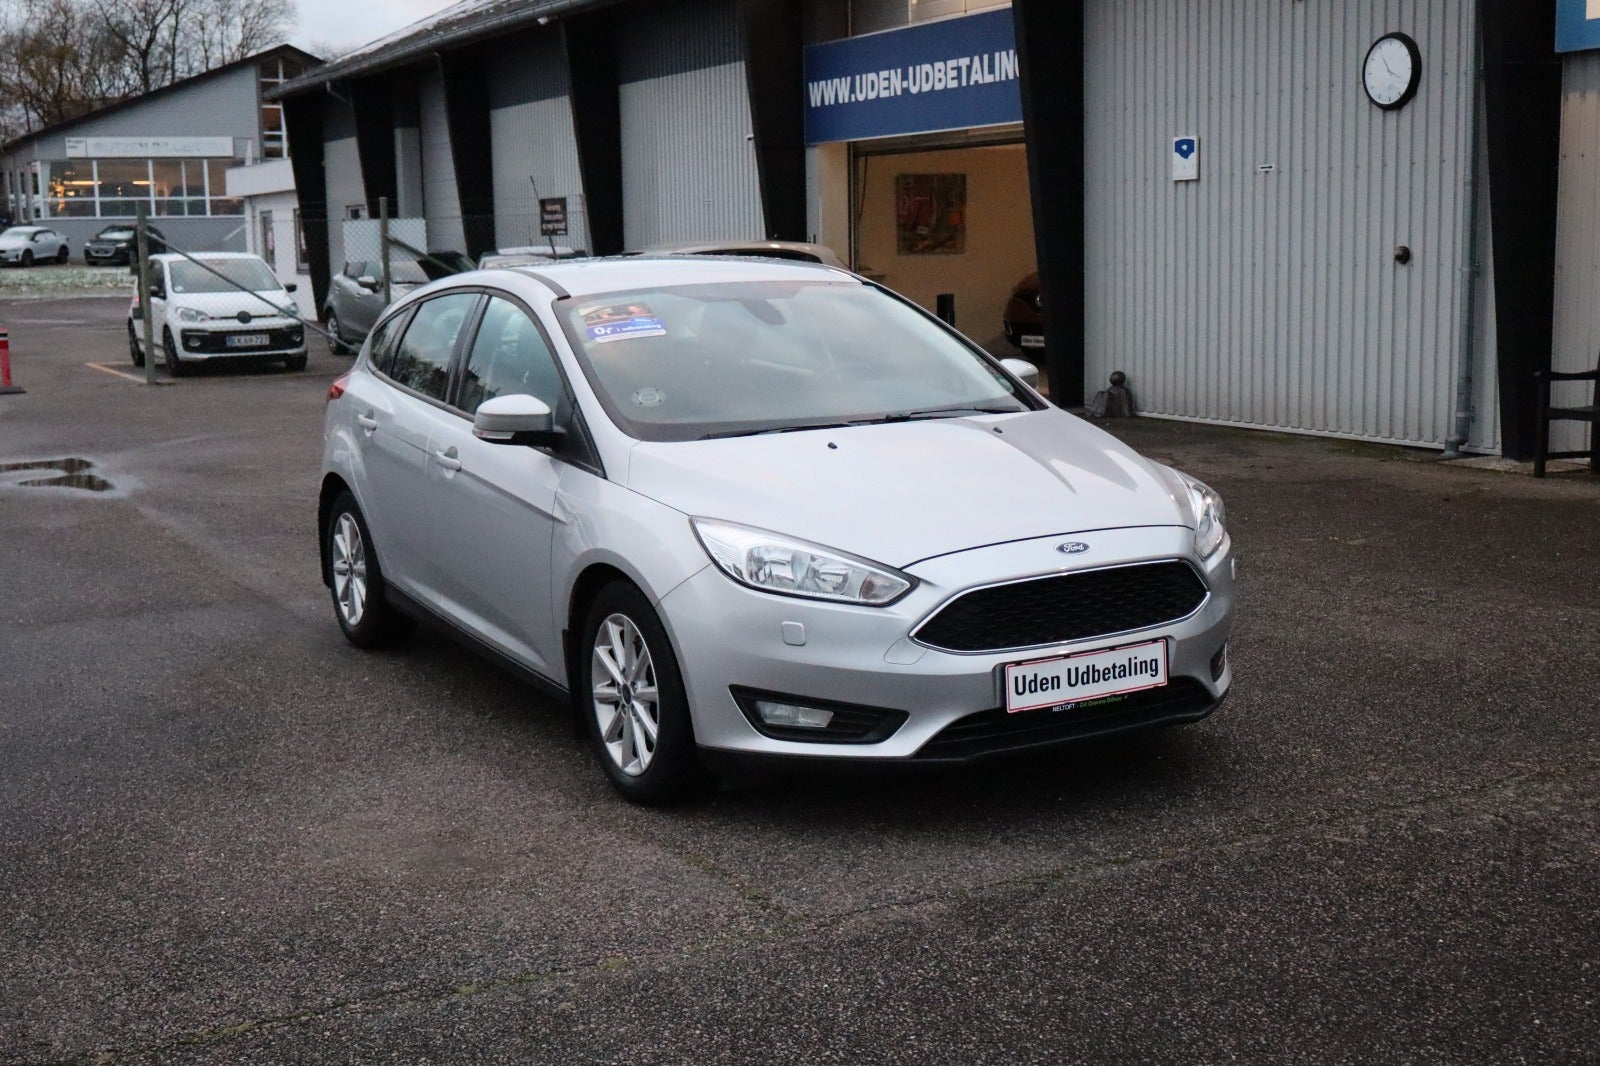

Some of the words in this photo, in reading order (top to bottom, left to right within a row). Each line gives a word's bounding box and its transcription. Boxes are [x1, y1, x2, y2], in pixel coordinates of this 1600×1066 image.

[1063, 542, 1085, 553] Ford
[1014, 672, 1061, 696] Uden
[1067, 656, 1159, 687] Udbetaling
[1052, 702, 1075, 712] NELTOFT
